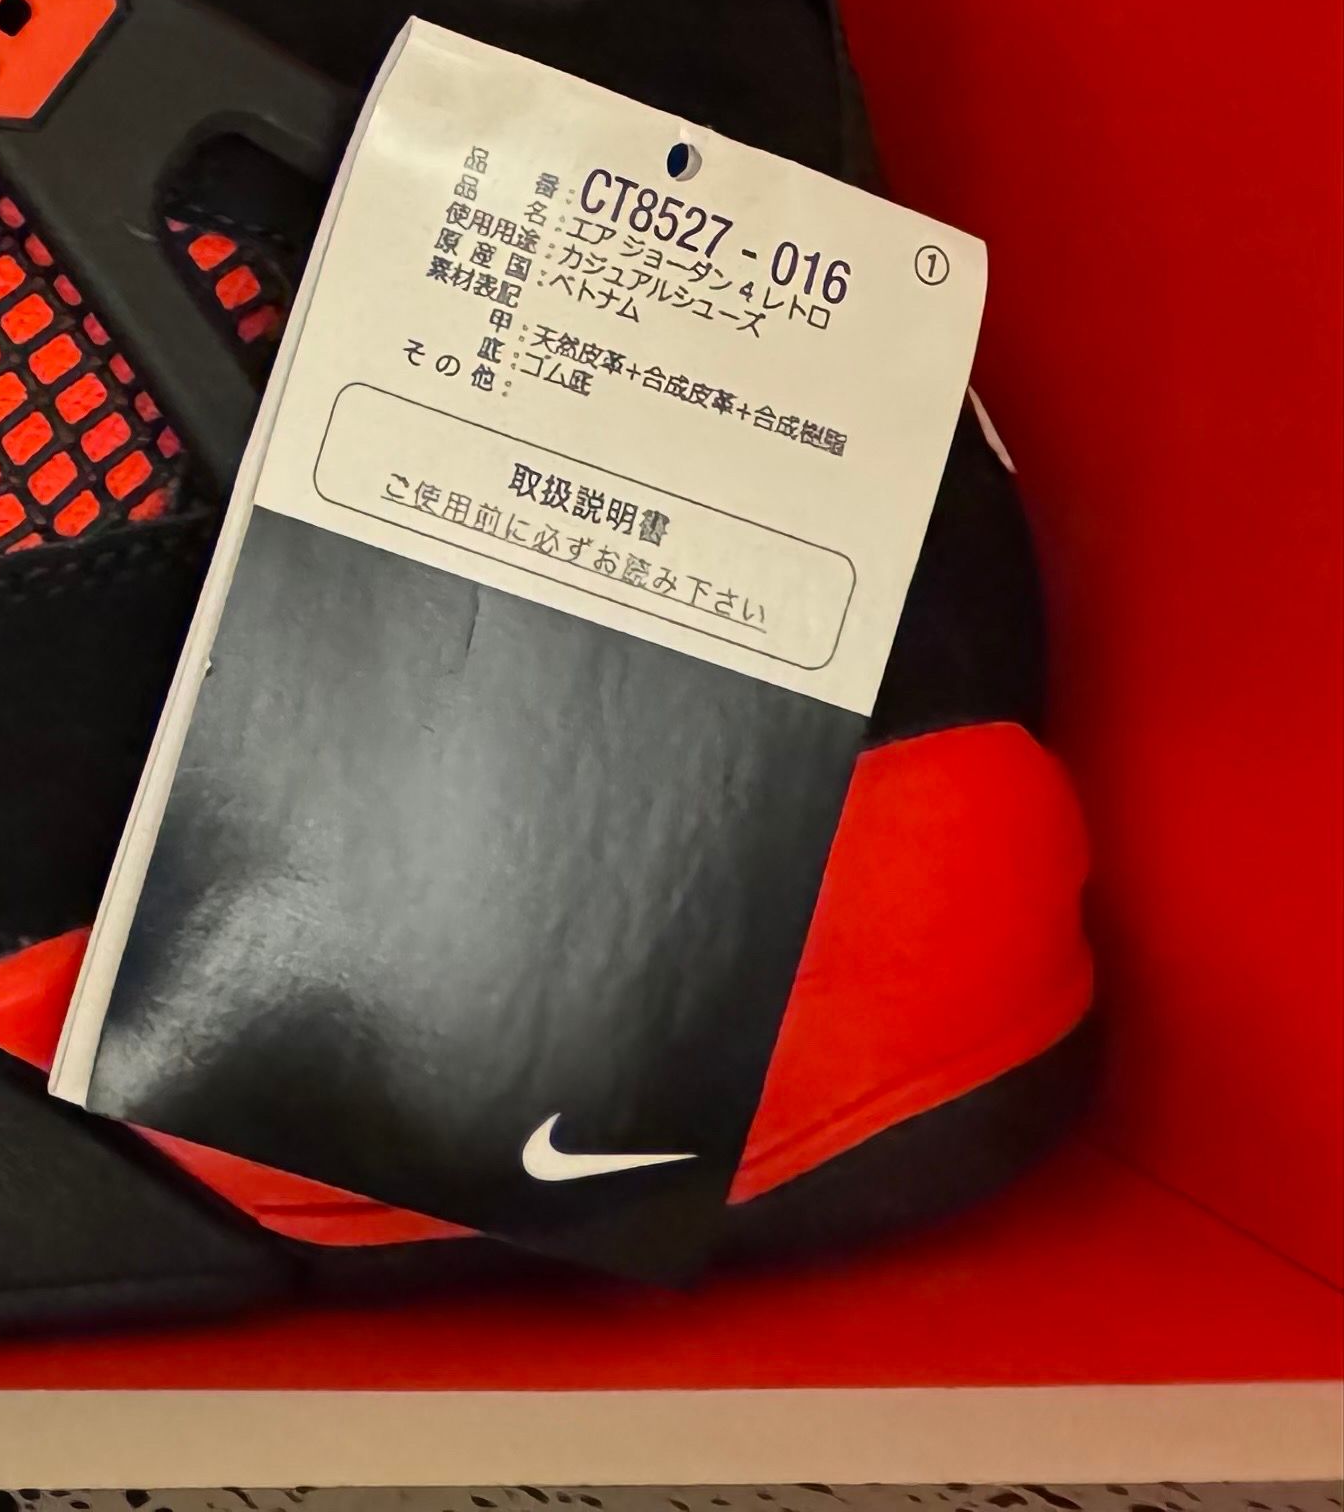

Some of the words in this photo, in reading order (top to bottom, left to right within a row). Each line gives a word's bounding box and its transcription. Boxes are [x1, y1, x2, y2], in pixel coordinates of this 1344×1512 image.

[580, 168, 733, 258] CT8527
[770, 241, 851, 304] 016
[425, 255, 522, 308] 素材表記
[507, 462, 671, 546] 取扱説明書
